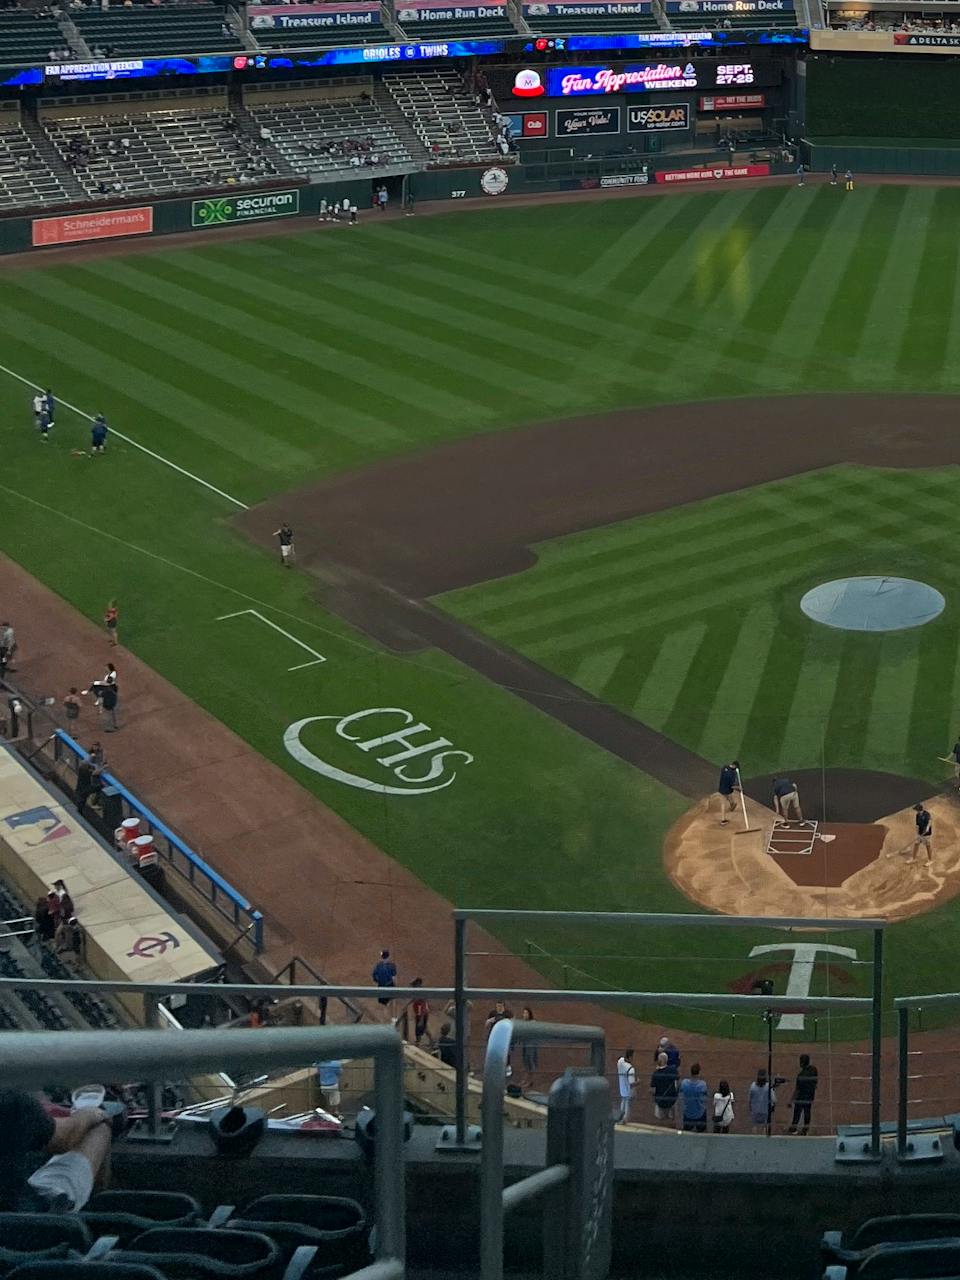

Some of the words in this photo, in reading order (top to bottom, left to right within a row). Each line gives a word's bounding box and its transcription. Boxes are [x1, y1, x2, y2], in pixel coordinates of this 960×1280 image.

[555, 5, 604, 15] Treasure
[606, 3, 641, 14] Island
[703, 2, 733, 11] Home
[735, 0, 755, 11] Run
[758, 0, 783, 10] Deck
[421, 11, 452, 20] Home
[455, 8, 476, 19] Run
[478, 7, 504, 18] Deck
[280, 16, 334, 28] Treasure
[336, 12, 371, 25] Island
[919, 37, 948, 45] DELTA
[363, 47, 400, 60] ORIOLES
[420, 45, 448, 56] TWINS
[45, 65, 60, 75] FAN
[60, 63, 110, 75] APPRECIATION
[716, 65, 753, 75] SEPT.
[562, 74, 592, 94] Fan
[593, 64, 682, 92] Appreciation
[645, 79, 697, 89] WEEKEND
[716, 74, 754, 85] 27-28
[451, 190, 466, 198] 377
[237, 193, 293, 209] securian
[237, 206, 277, 217] FINANCIAL
[63, 214, 145, 231] Schneiderman's
[336, 708, 474, 782] CHS
